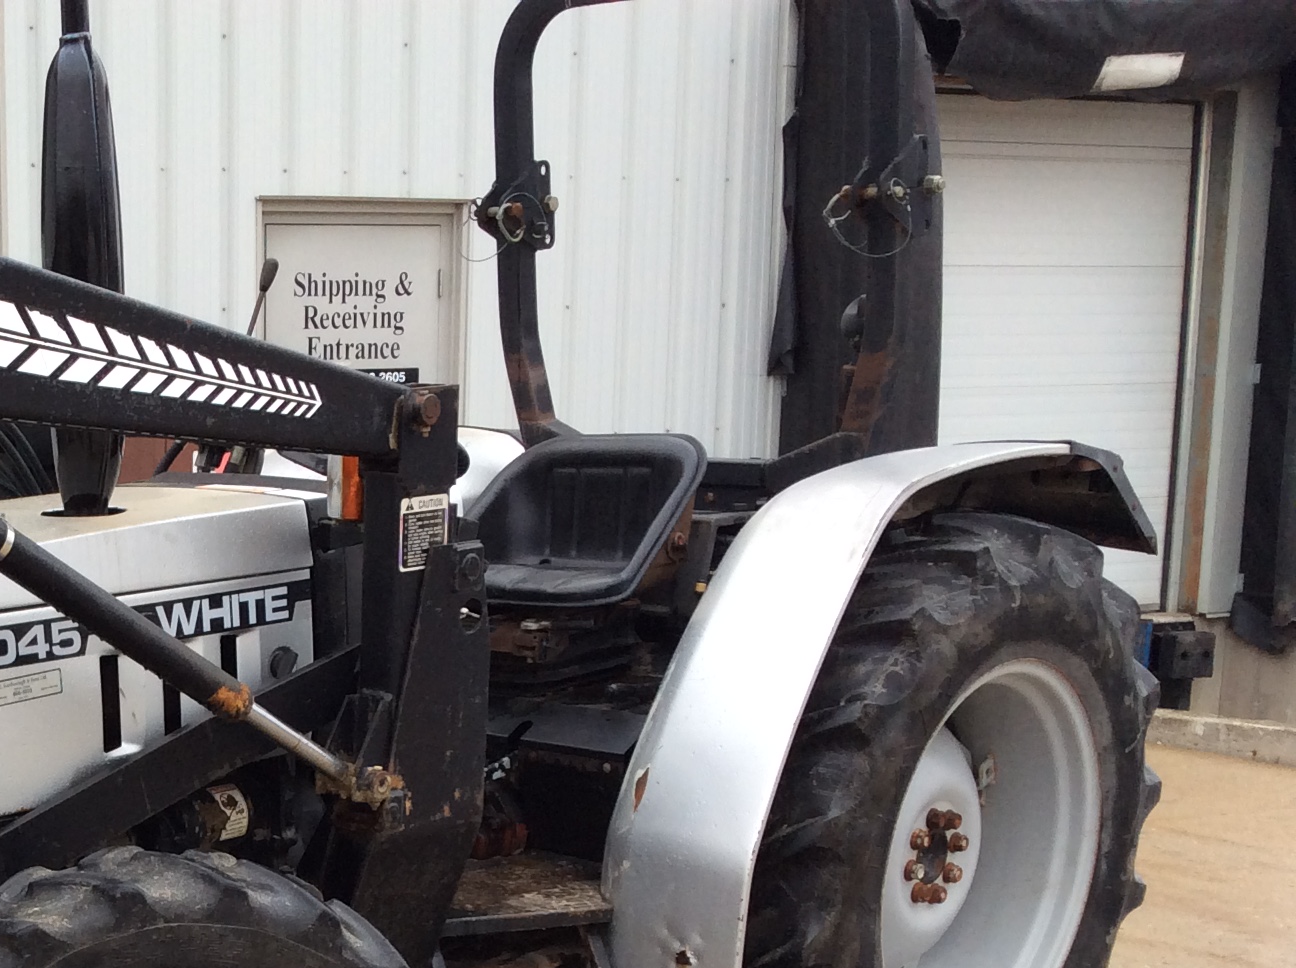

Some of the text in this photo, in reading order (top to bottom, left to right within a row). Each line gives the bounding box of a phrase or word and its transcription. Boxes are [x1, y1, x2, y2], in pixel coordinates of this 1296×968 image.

[293, 271, 413, 304] Shipping &
[303, 305, 405, 335] Receiving
[307, 336, 400, 361] Entrance
[418, 498, 443, 510] CAUTION
[155, 585, 290, 637] WHITE
